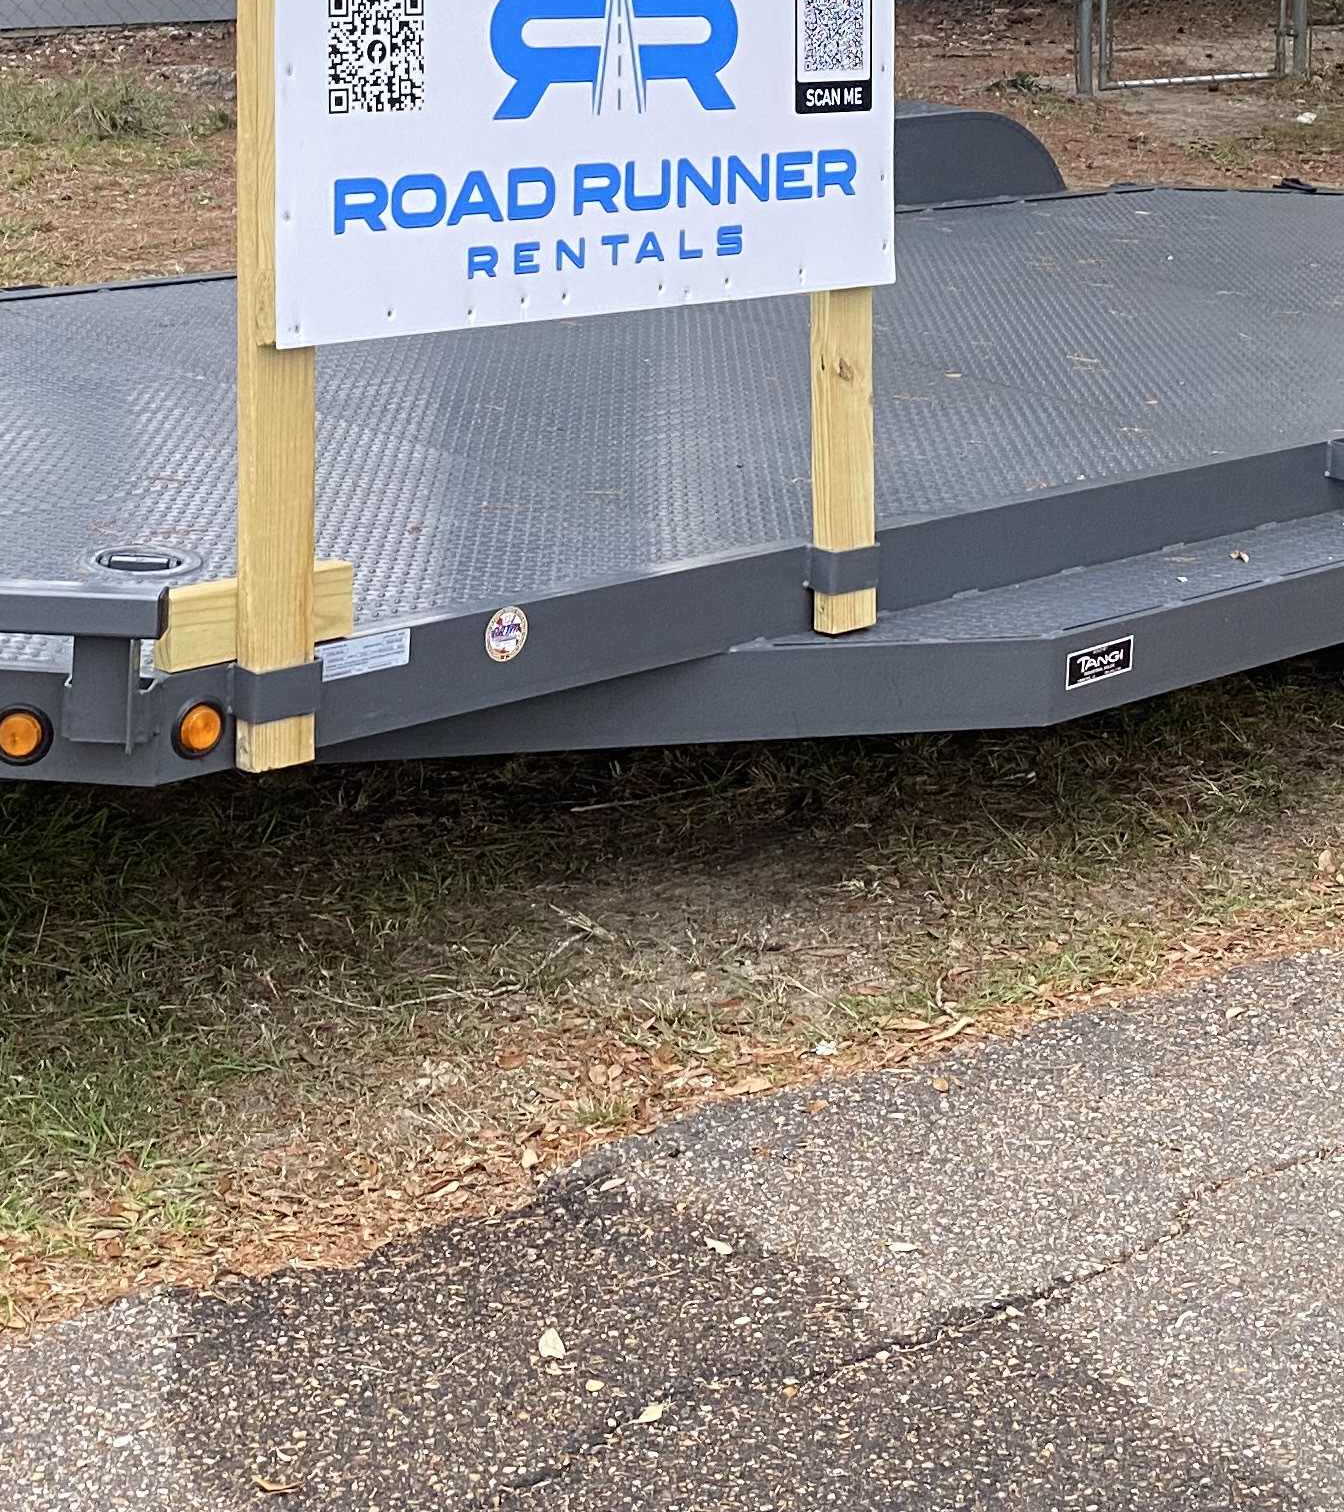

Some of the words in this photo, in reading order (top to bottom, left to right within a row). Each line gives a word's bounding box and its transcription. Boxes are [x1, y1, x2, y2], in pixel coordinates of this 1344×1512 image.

[806, 88, 841, 107] SCAN
[843, 87, 863, 106] ME
[333, 167, 557, 235] ROAD
[572, 149, 858, 217] RUNNER
[467, 225, 743, 279] RENTALS
[1076, 648, 1124, 674] TANGI
